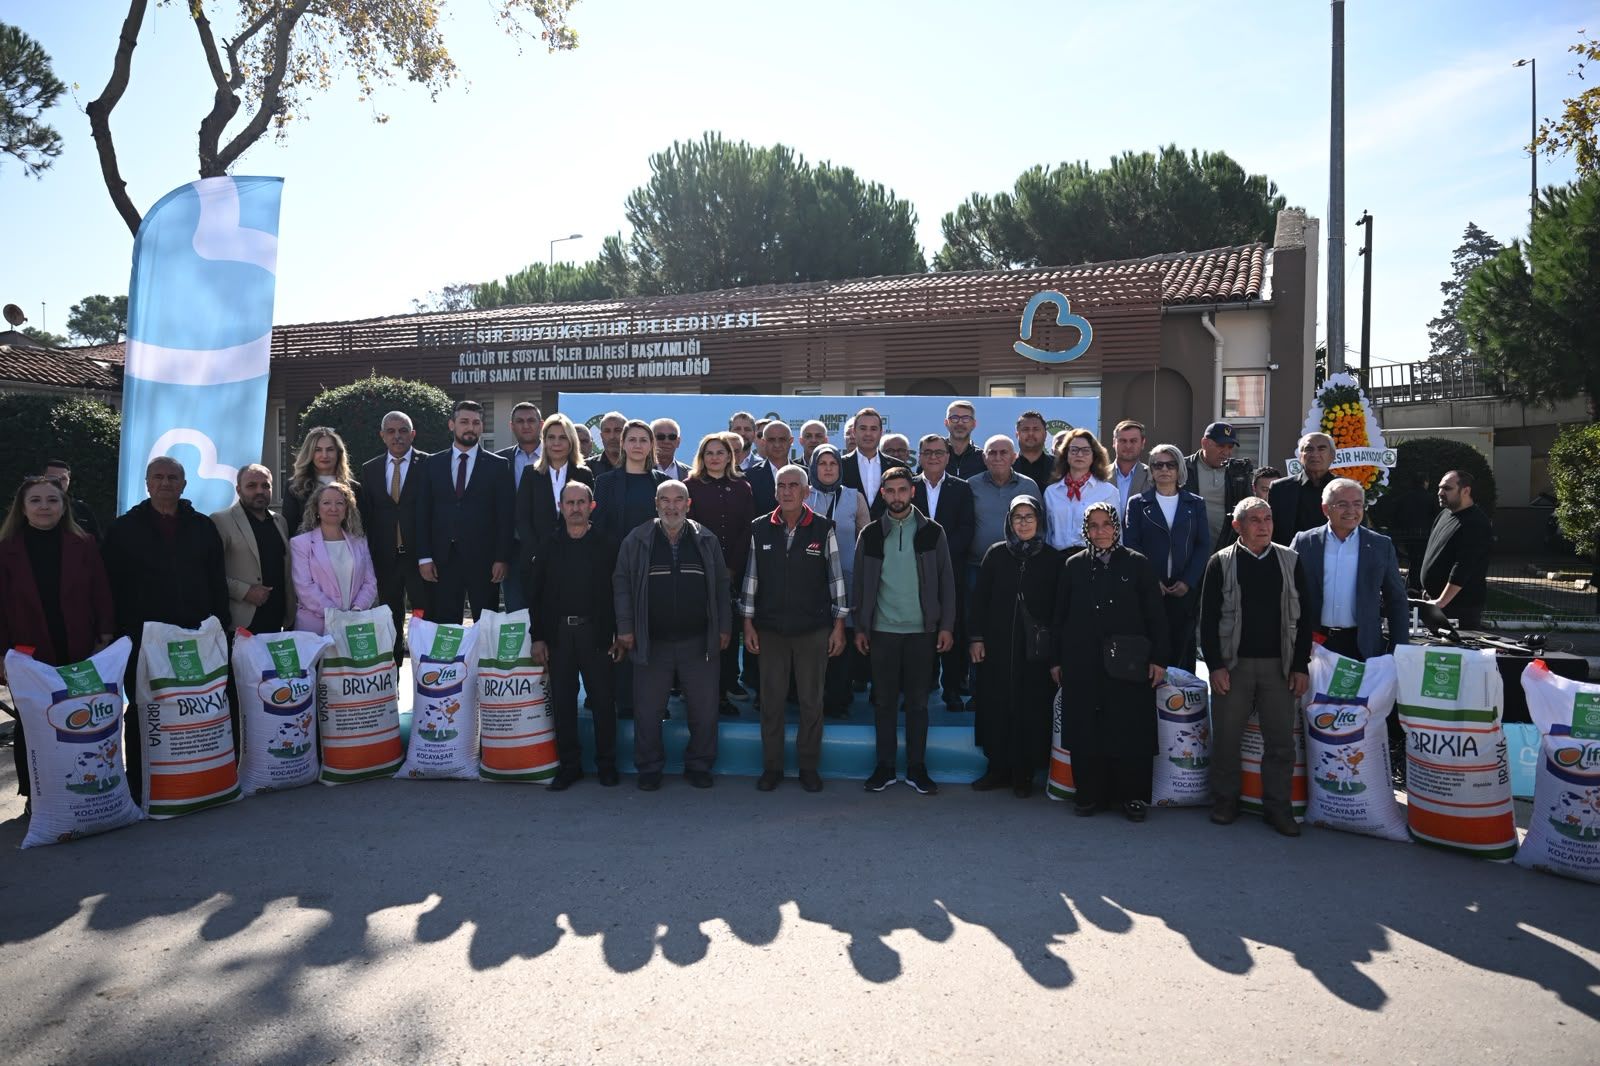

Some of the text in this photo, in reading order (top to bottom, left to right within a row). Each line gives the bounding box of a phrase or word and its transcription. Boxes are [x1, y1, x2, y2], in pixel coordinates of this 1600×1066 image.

[460, 338, 700, 366] KÜLTÜR VE SOSYAL İŞLER DAİRESİ BAŞKANLIĞI
[451, 357, 710, 384] KÜLTÜR SANAT VE ETKİNLİKLER ŞUBE MÜDÜRLÜĞÜ
[343, 673, 393, 695] BRIXIA
[485, 679, 531, 696] BRIXIA
[177, 688, 228, 716] BRIXIA
[147, 703, 161, 747] BRIXIA
[1320, 803, 1367, 816] KOCAYAŞAR
[1547, 847, 1600, 864] KOCAYAŞA
